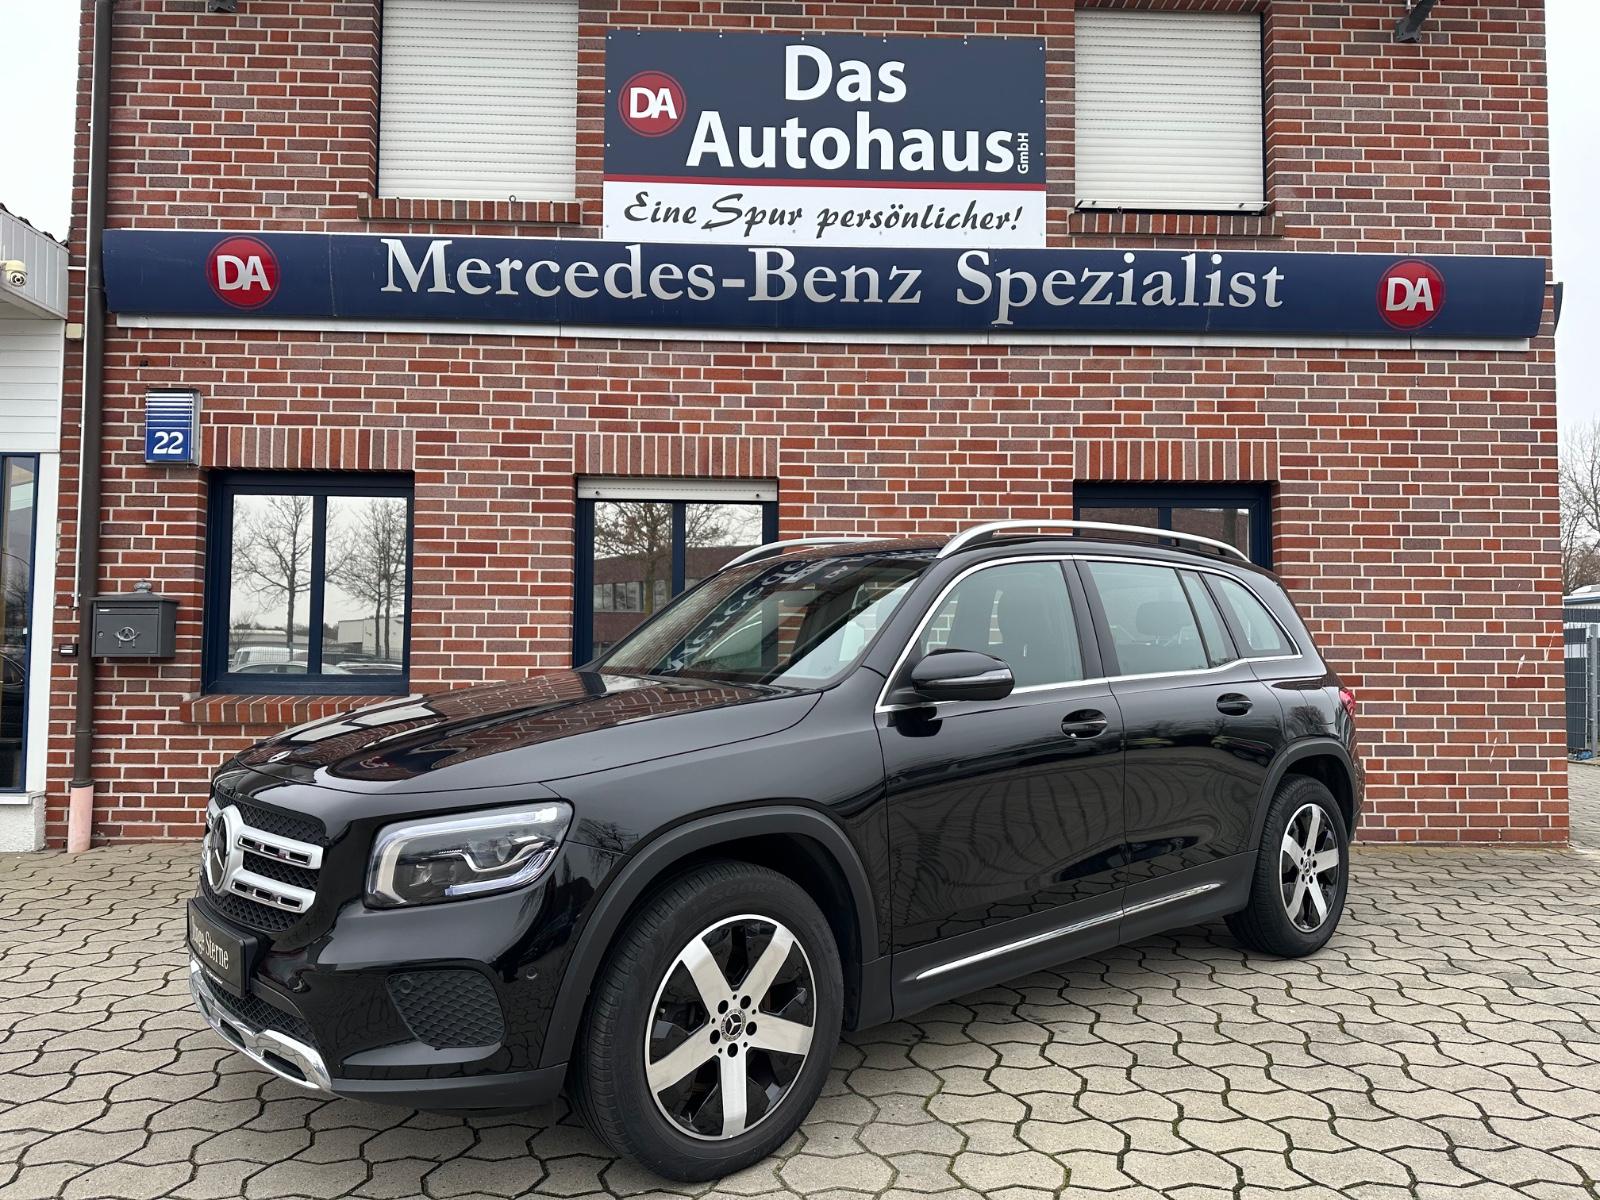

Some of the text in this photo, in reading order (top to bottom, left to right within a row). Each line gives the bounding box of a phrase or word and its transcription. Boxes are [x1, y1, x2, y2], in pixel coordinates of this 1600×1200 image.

[785, 44, 907, 103] Das
[629, 87, 678, 120] DA
[685, 110, 1015, 173] Autohaus
[1017, 132, 1029, 174] GmbH
[624, 191, 1023, 239] Eine Spur persönlicher!
[216, 254, 271, 291] DA
[380, 238, 1286, 325] Mercedes-Benz Spezialist
[1385, 277, 1434, 311] DA
[152, 431, 184, 455] 22
[205, 931, 229, 970] Sterne
